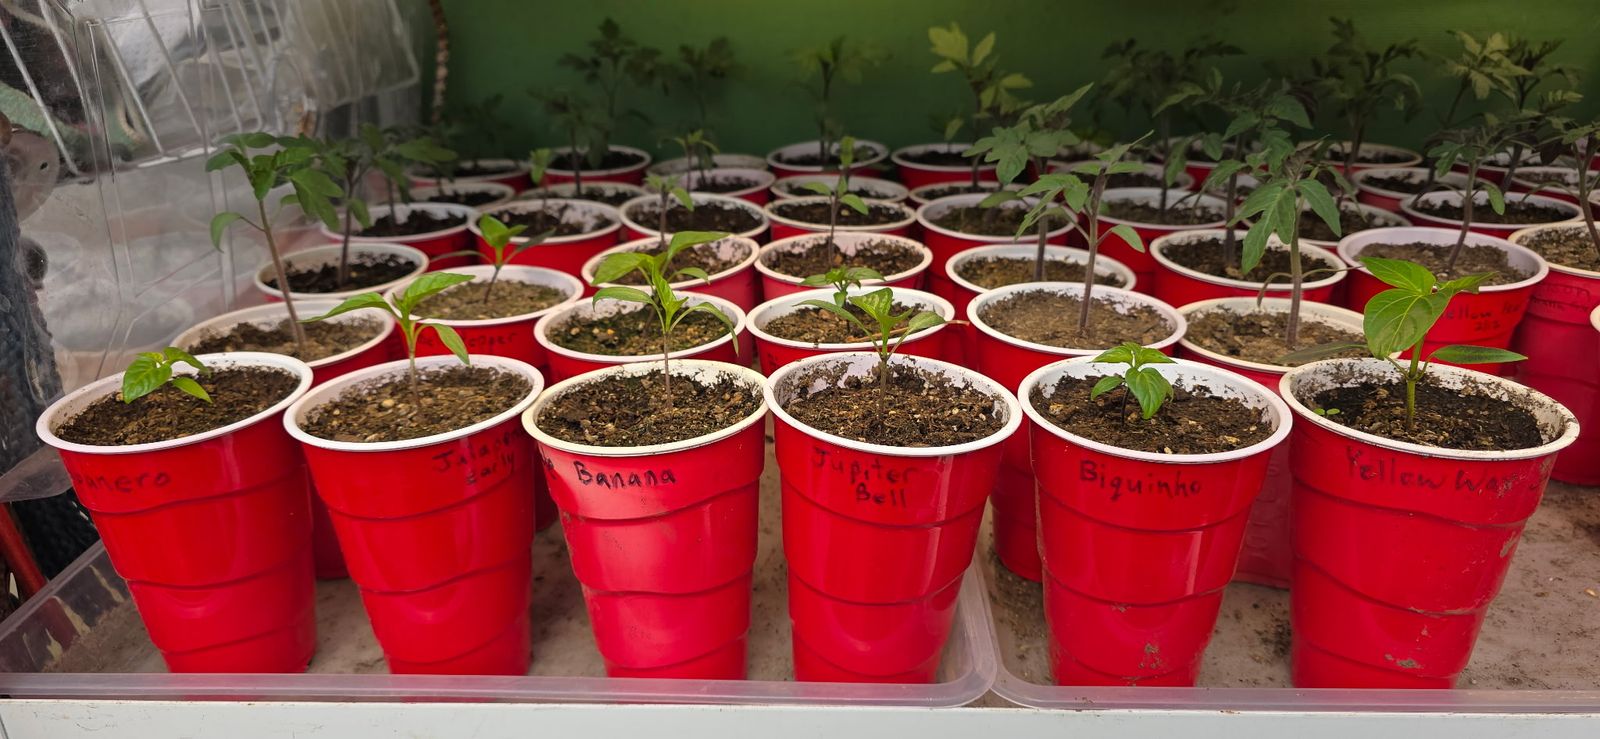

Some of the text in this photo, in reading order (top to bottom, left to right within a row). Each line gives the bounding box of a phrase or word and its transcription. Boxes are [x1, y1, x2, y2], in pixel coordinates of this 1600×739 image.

[1445, 303, 1492, 320] ellow
[573, 461, 676, 489] Banana
[811, 446, 919, 484] Jupiter
[1079, 460, 1201, 502] Biquinho
[1346, 446, 1444, 490] Yellow
[856, 482, 907, 507] Bell
